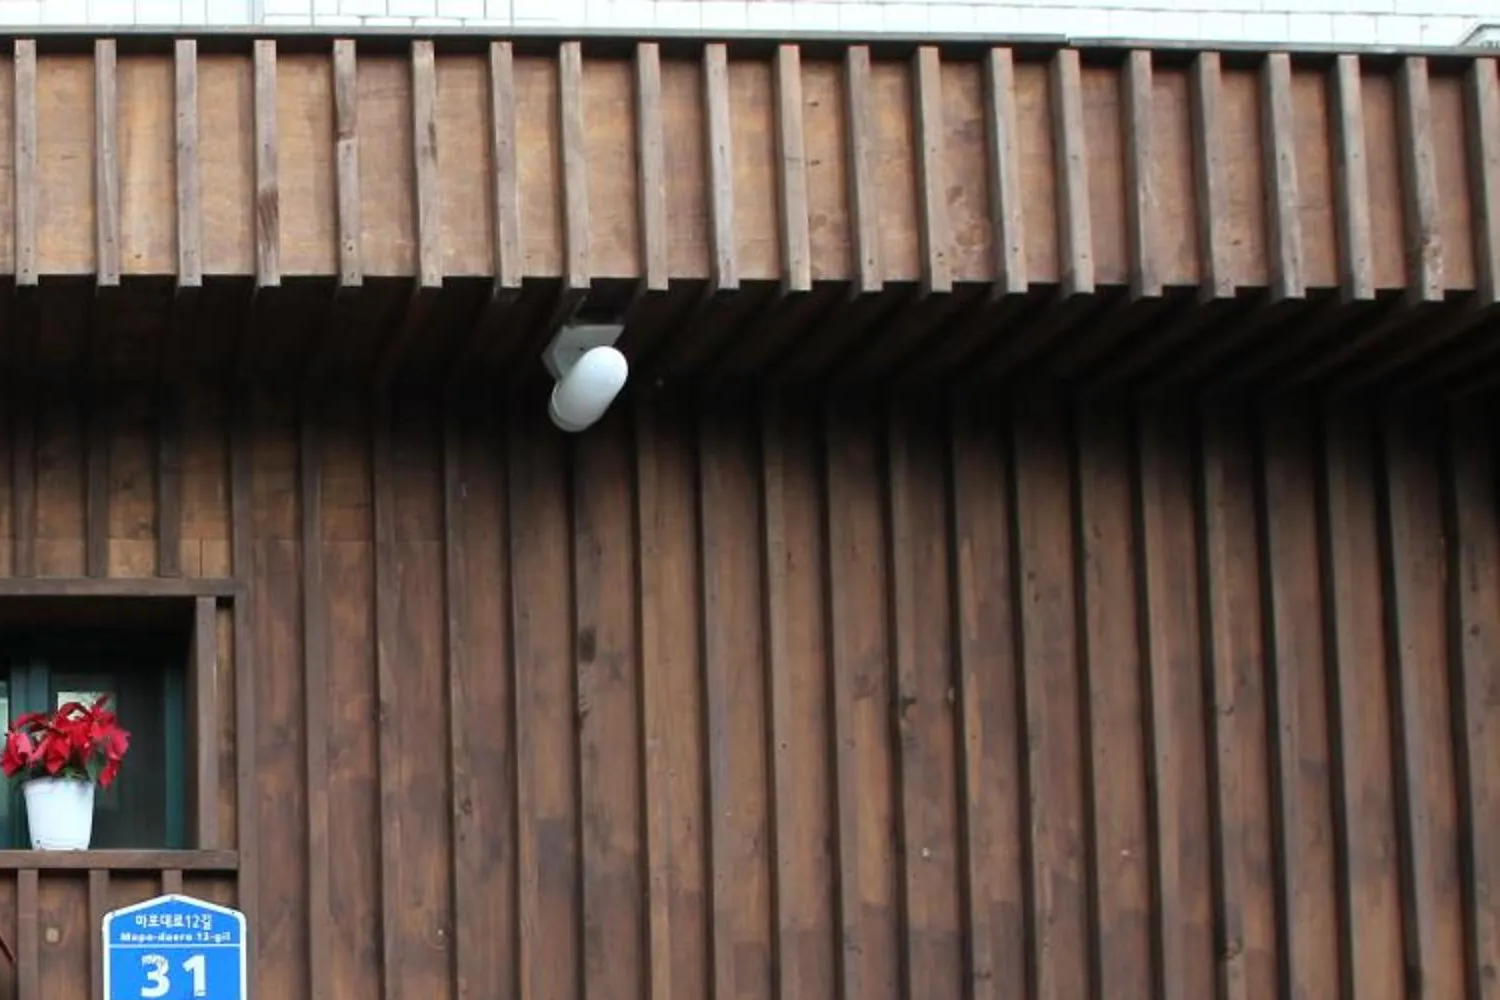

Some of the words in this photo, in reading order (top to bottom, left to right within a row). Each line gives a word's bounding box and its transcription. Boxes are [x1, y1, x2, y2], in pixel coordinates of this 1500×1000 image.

[135, 913, 213, 931] 마포대로12길
[119, 931, 193, 943] Mapo-daero
[140, 953, 207, 998] 31
